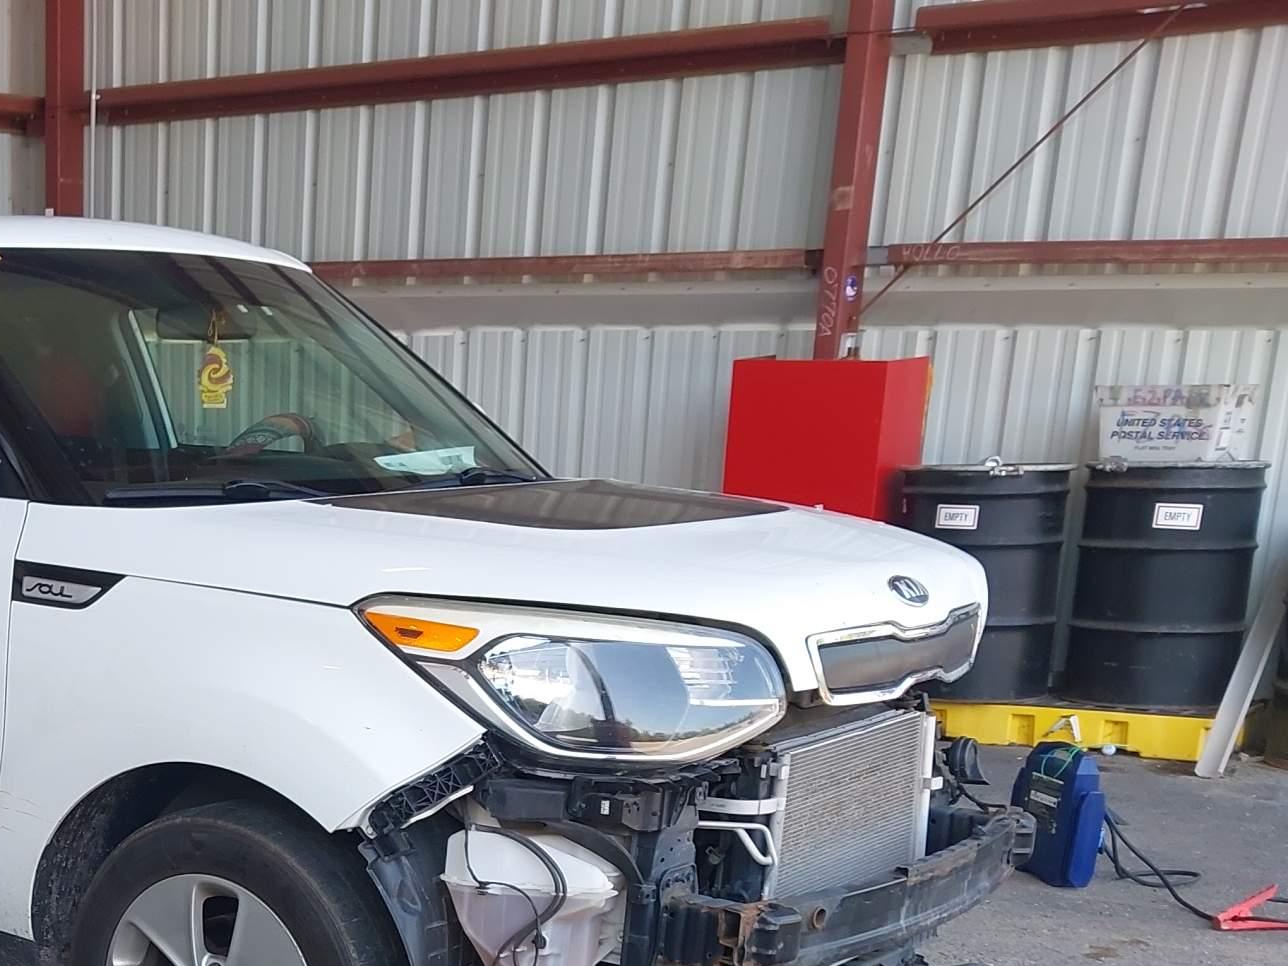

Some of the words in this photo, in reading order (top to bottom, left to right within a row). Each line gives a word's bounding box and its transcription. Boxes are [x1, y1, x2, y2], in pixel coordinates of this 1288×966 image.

[1116, 417, 1157, 428] UNITED
[1159, 417, 1204, 428] STATES
[1110, 430, 1153, 441] POSTAL
[943, 511, 970, 522] EMPTY
[1163, 510, 1192, 523] EMPTY
